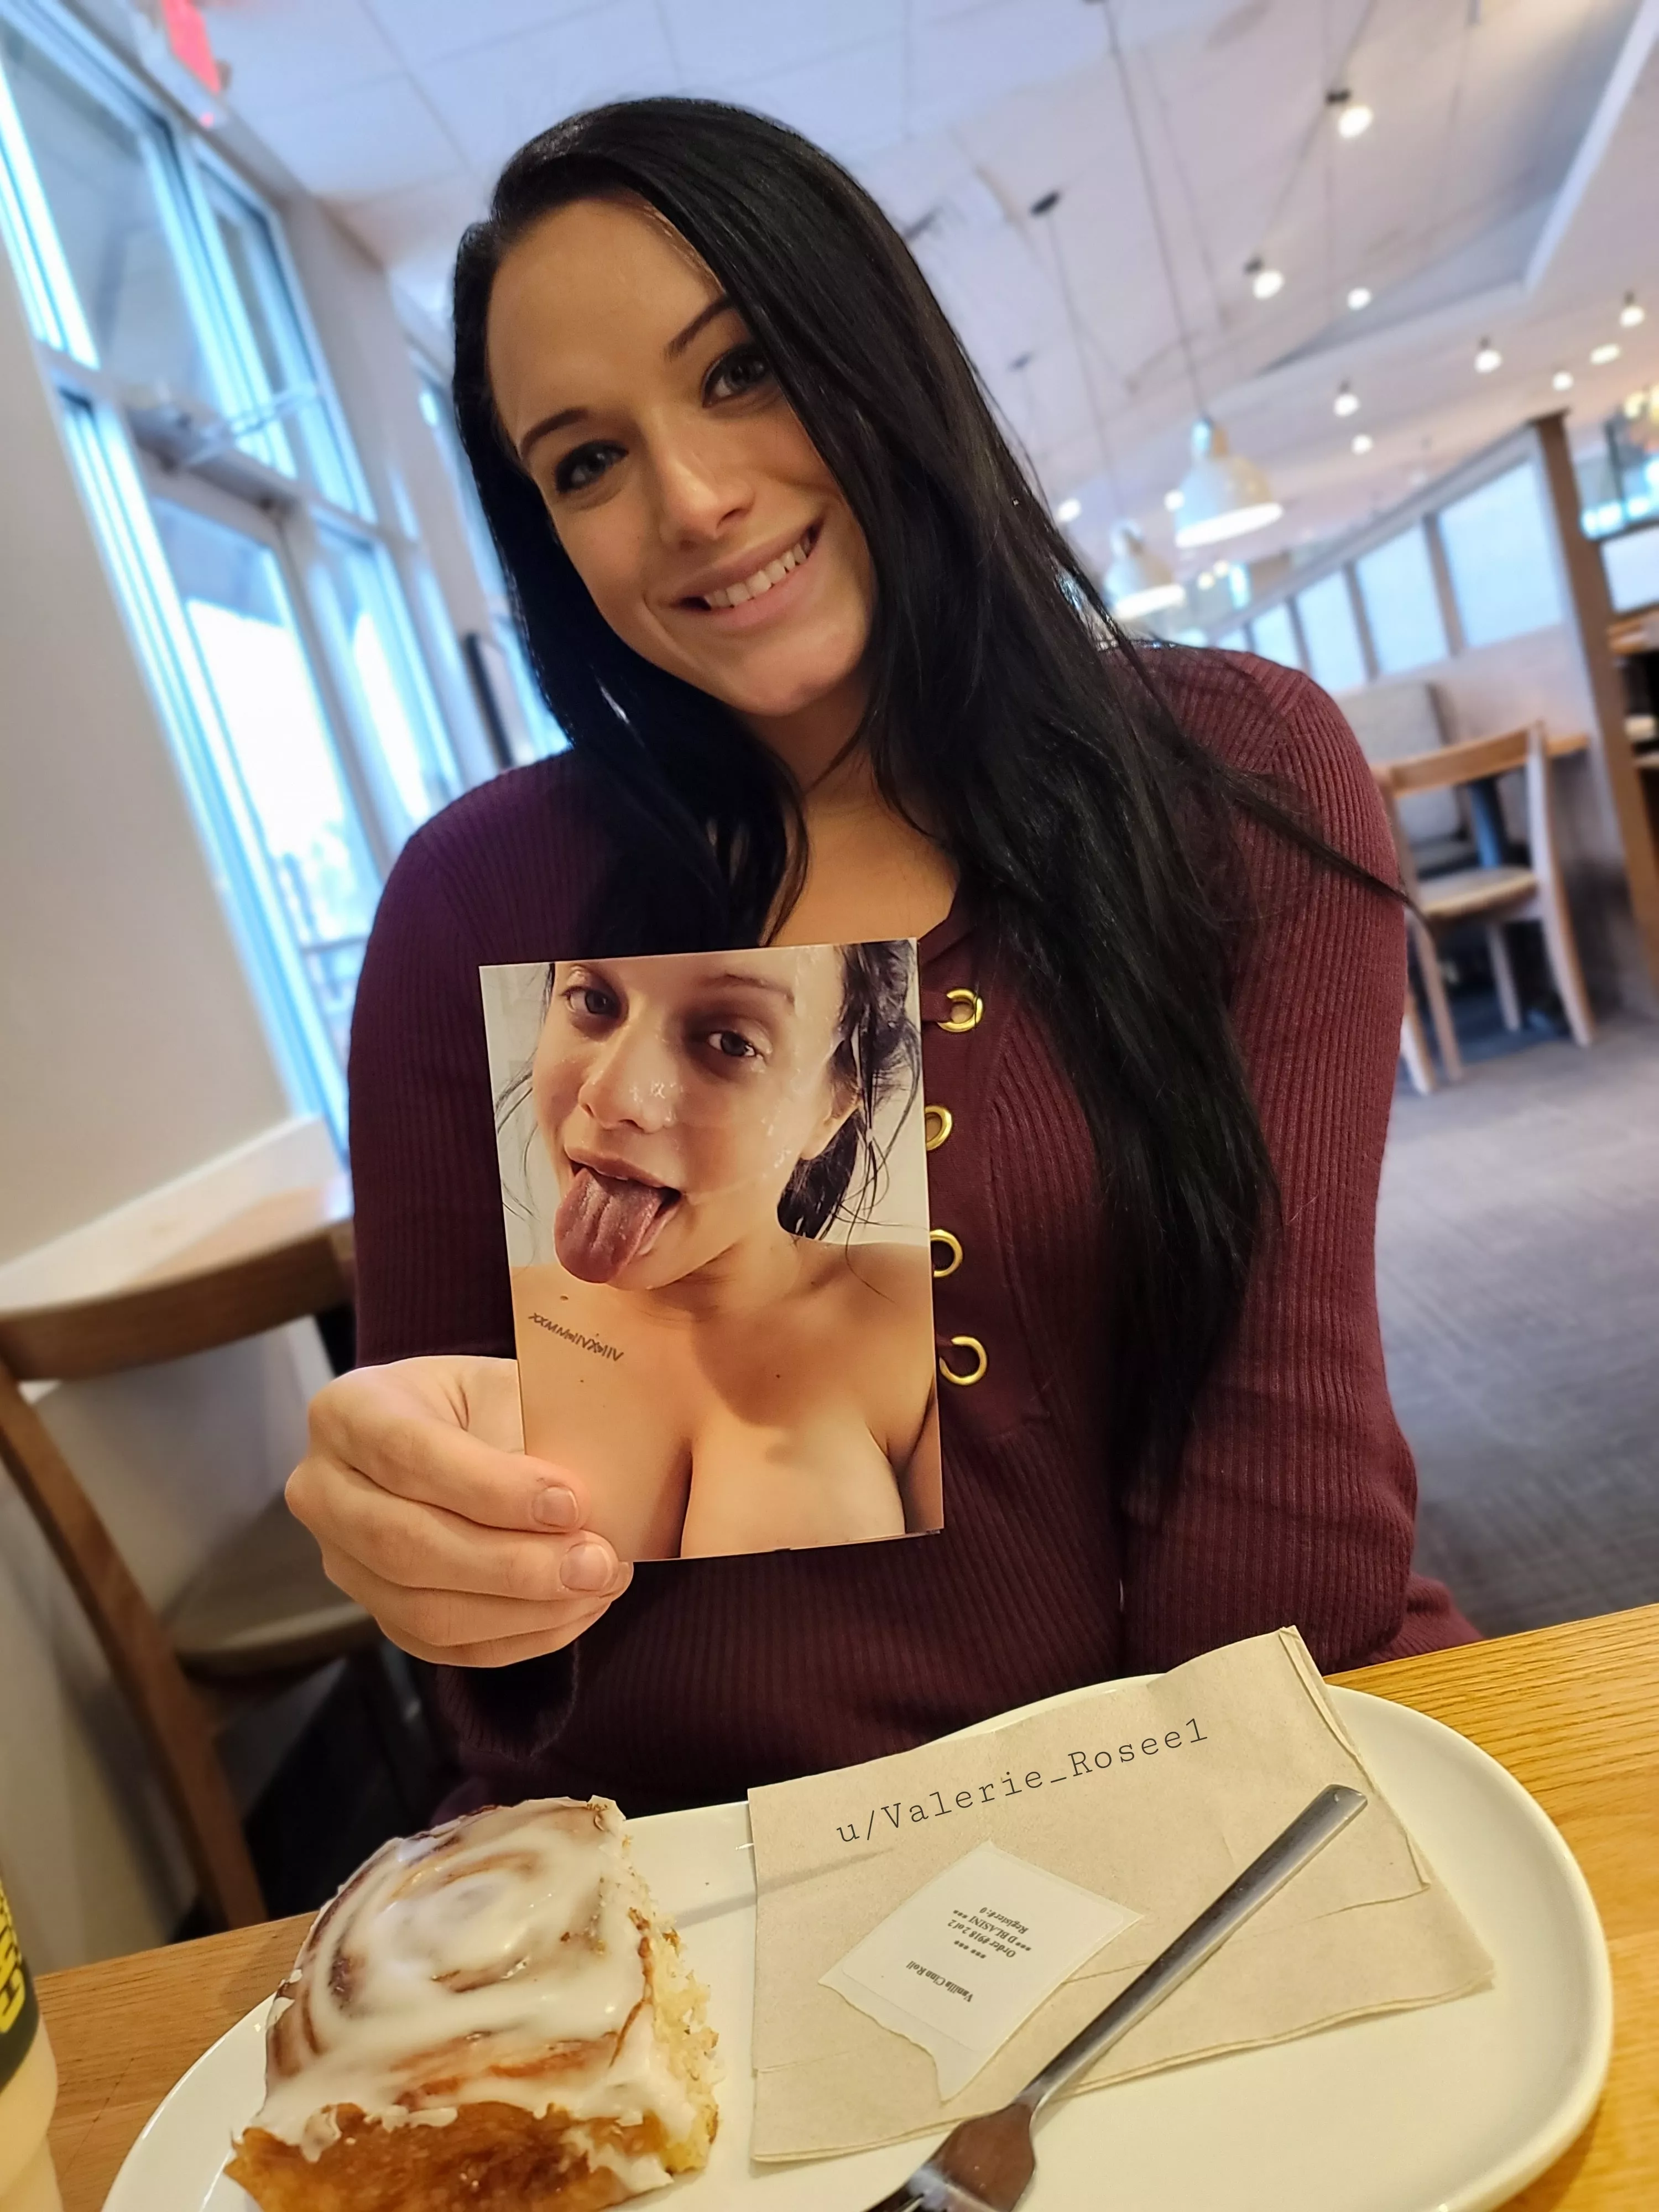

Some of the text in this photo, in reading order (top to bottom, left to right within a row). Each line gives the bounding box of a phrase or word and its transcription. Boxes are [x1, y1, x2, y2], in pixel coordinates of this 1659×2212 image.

[968, 1916, 1010, 1939] BLASINI
[968, 1931, 990, 1944] #918
[989, 1940, 1016, 1958] Order
[906, 1960, 927, 1975] Roll
[945, 1981, 973, 2002] Vanilla
